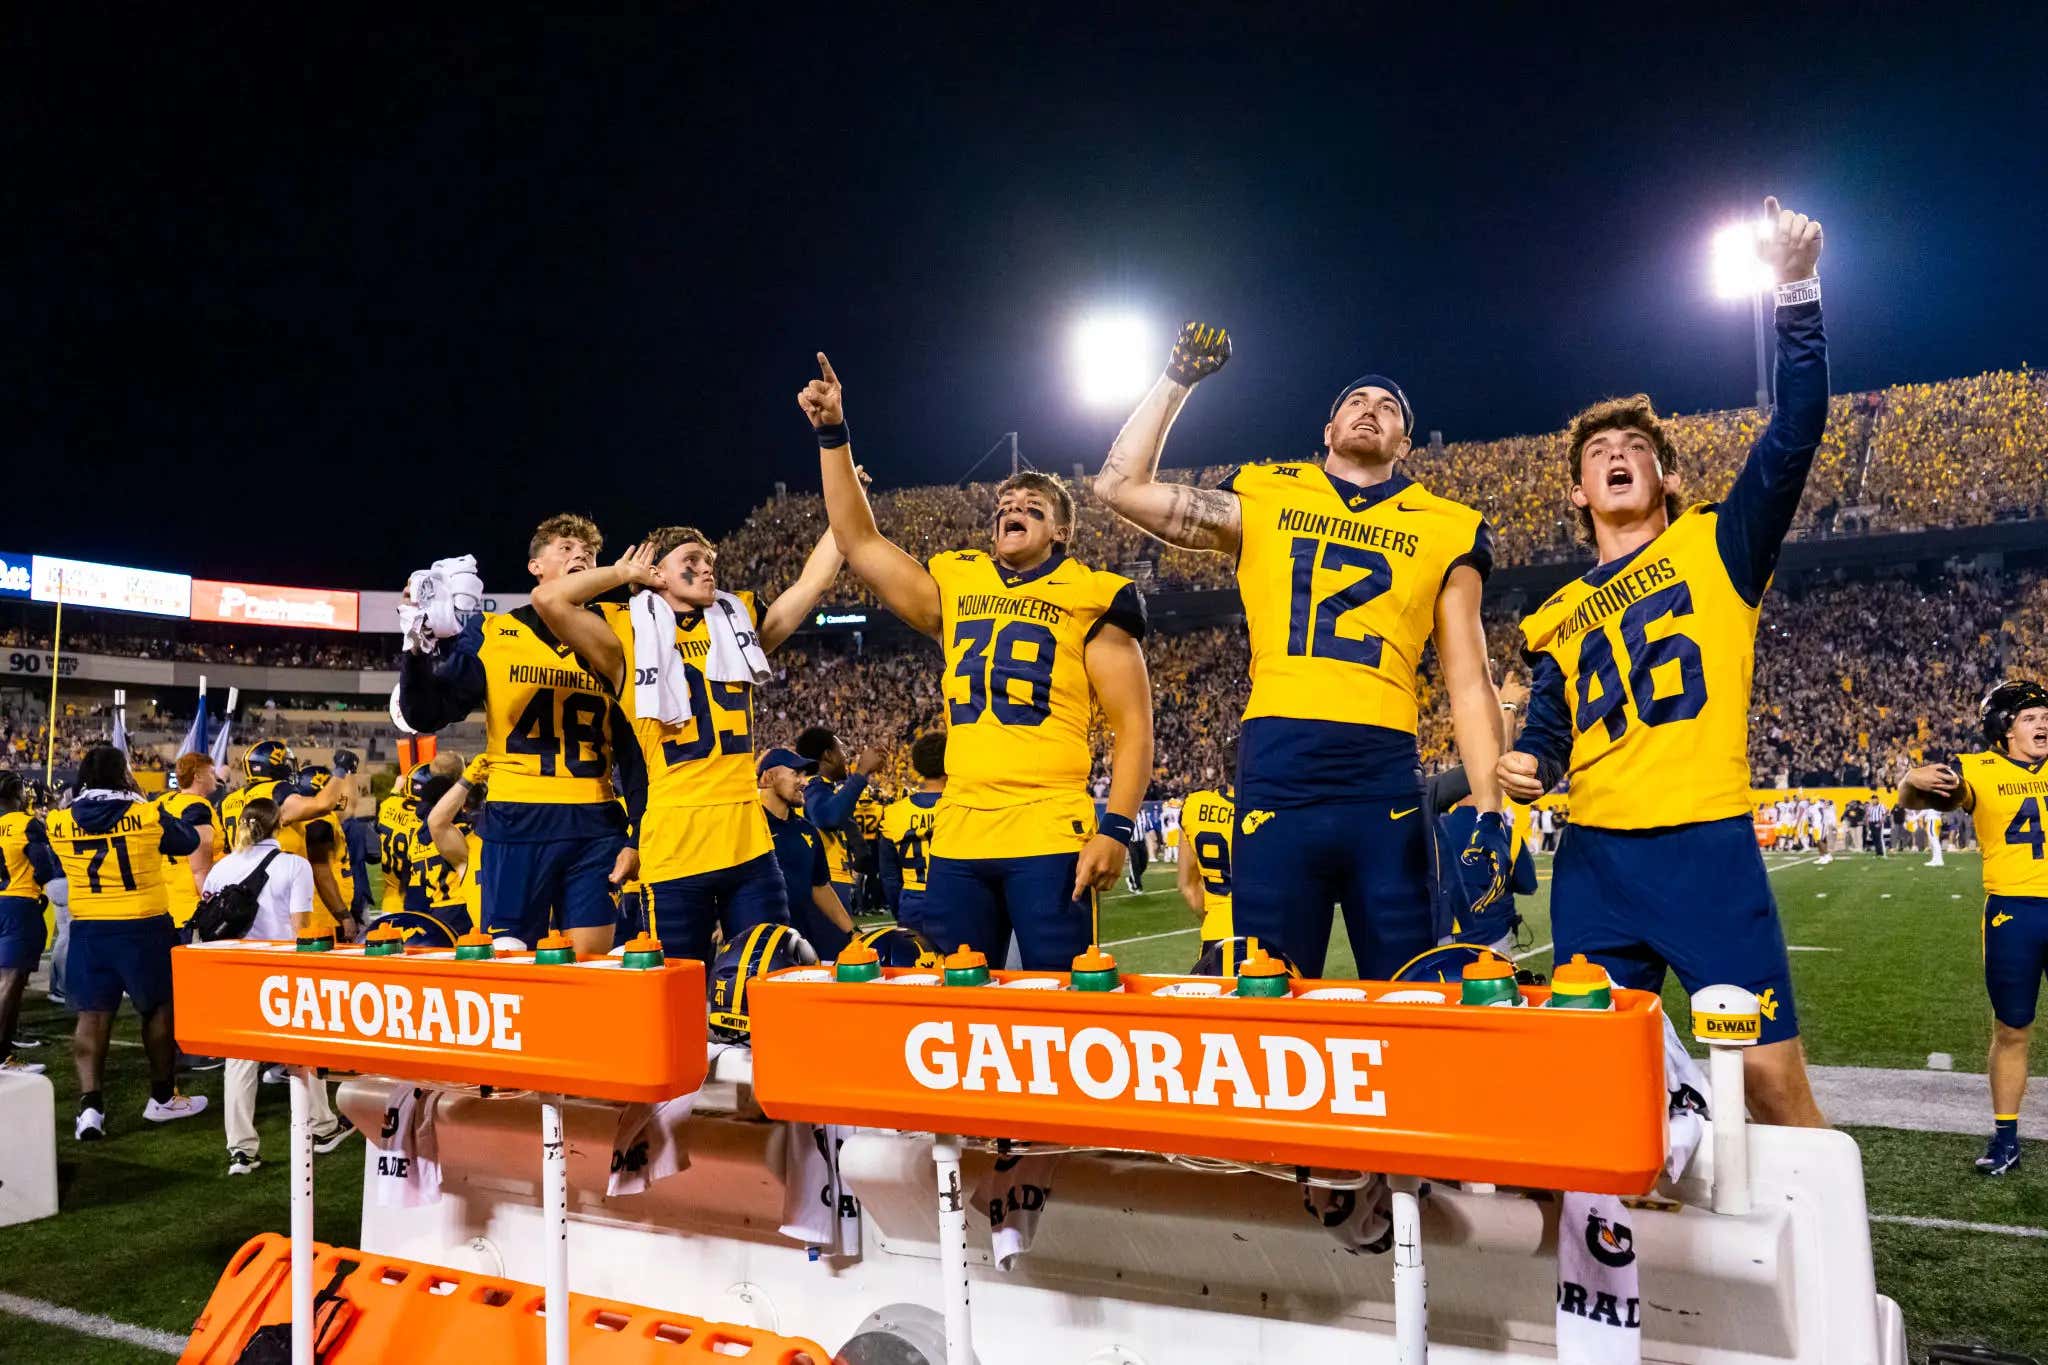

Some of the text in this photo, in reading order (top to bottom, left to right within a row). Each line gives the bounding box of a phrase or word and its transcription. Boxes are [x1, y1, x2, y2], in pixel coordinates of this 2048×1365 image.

[1278, 508, 1419, 557] MOUNTAINEERS
[957, 595, 1060, 625] MOUNTAINEERS
[1287, 537, 1393, 669] 12
[1557, 557, 1676, 648] MOUNTAINEERS
[9, 653, 41, 673] 90
[509, 664, 606, 693] MOUNTAINEER
[949, 619, 1057, 726] 38
[1575, 580, 1708, 743] 46
[506, 687, 607, 778] 48
[2005, 796, 2048, 860] 4
[73, 835, 138, 894] 71
[259, 974, 523, 1052] GATORADE
[714, 990, 724, 1007] 41
[904, 1021, 1387, 1117] GATORADE
